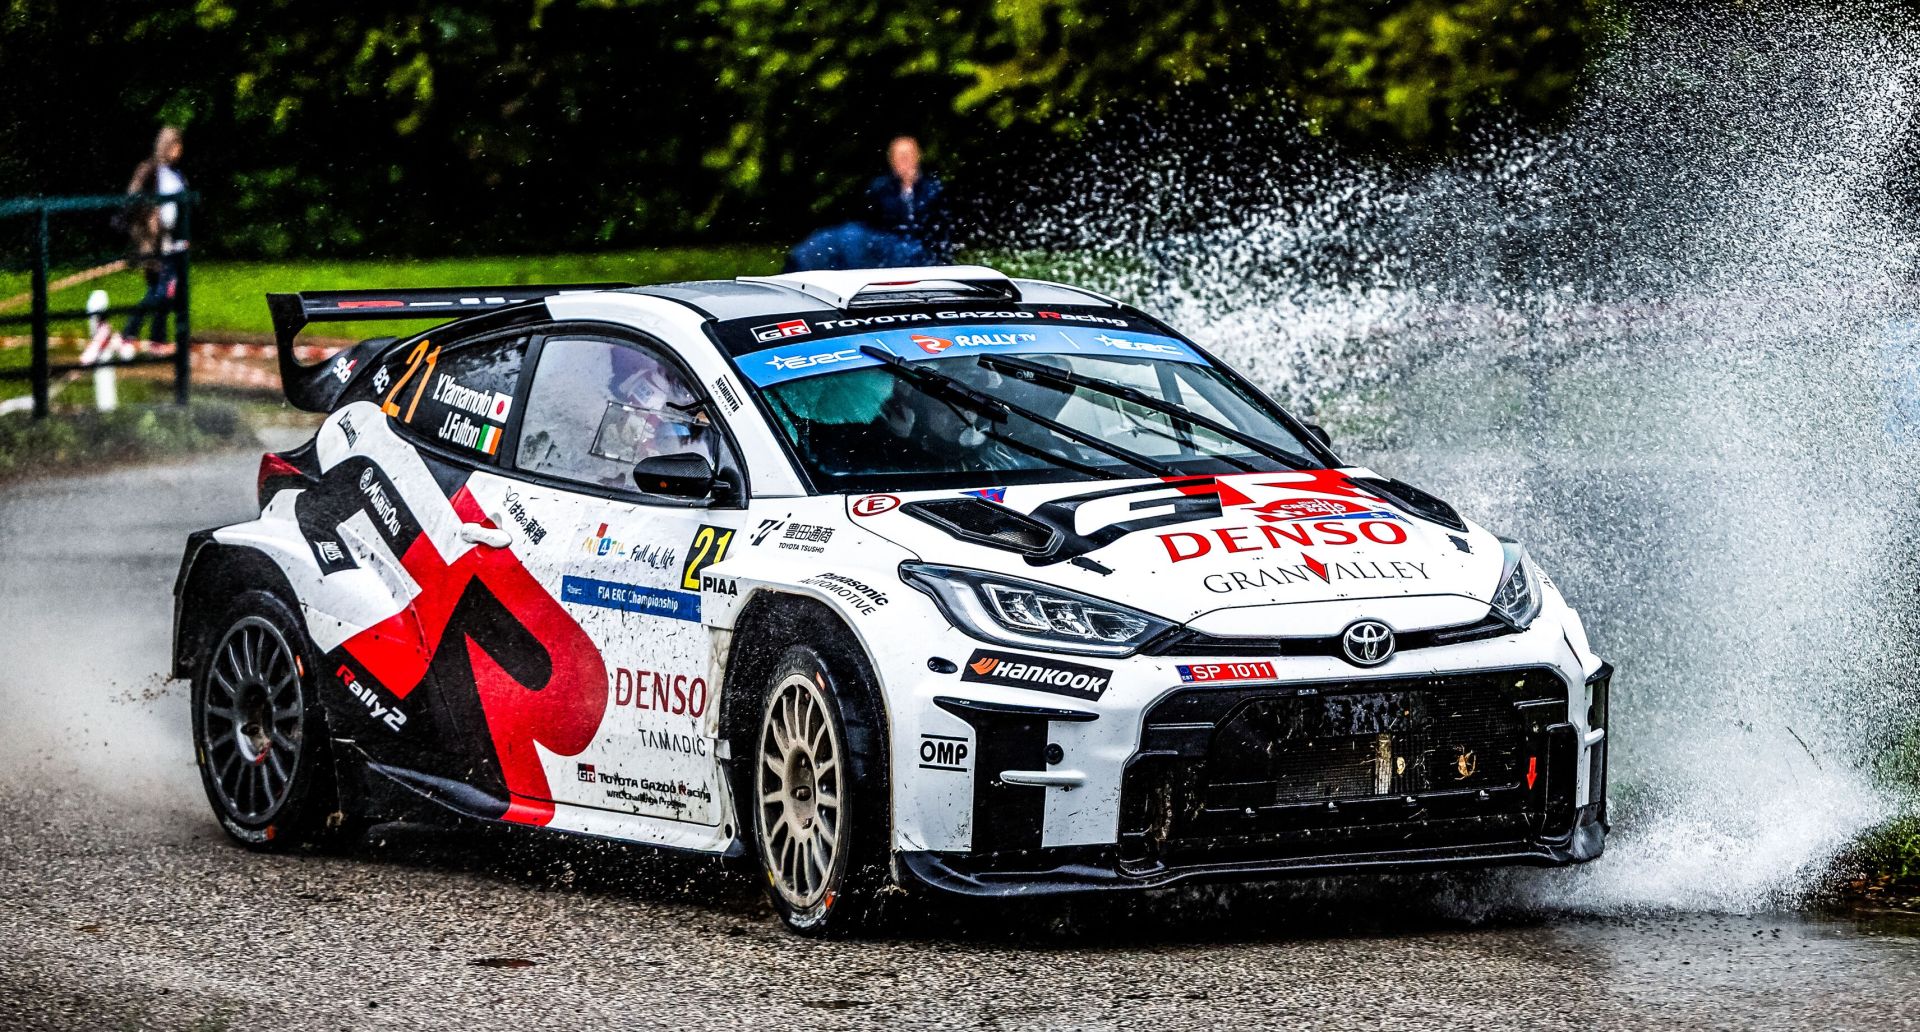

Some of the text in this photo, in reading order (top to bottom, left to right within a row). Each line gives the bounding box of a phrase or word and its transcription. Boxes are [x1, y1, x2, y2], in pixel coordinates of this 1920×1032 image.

[757, 311, 1128, 342] GR TOYOTA GAZOO Racing
[783, 348, 863, 369] ERC
[381, 340, 441, 423] 21
[433, 373, 492, 417] Y.Yamamoto
[438, 411, 480, 449] J.Fulton
[867, 498, 885, 512] E
[779, 542, 824, 553] TOYOTA TSUSHO
[1156, 521, 1408, 563] DENSO
[684, 527, 733, 589] 21
[598, 586, 610, 600] FIA
[612, 588, 626, 602] ERC
[628, 590, 678, 613] Championship
[703, 576, 738, 596] PIAA
[798, 578, 876, 616] AUTOMOTIVE
[815, 572, 889, 606] Panasonic
[1192, 665, 1220, 679] SP
[1227, 663, 1271, 678] 1011
[336, 664, 407, 732] Rally2
[616, 668, 707, 718] DENSO
[638, 729, 706, 757] TAMADIC
[919, 740, 968, 766] OMP
[598, 773, 638, 788] TOYOTA
[641, 778, 676, 794] GAZOO
[678, 783, 711, 803] Racing
